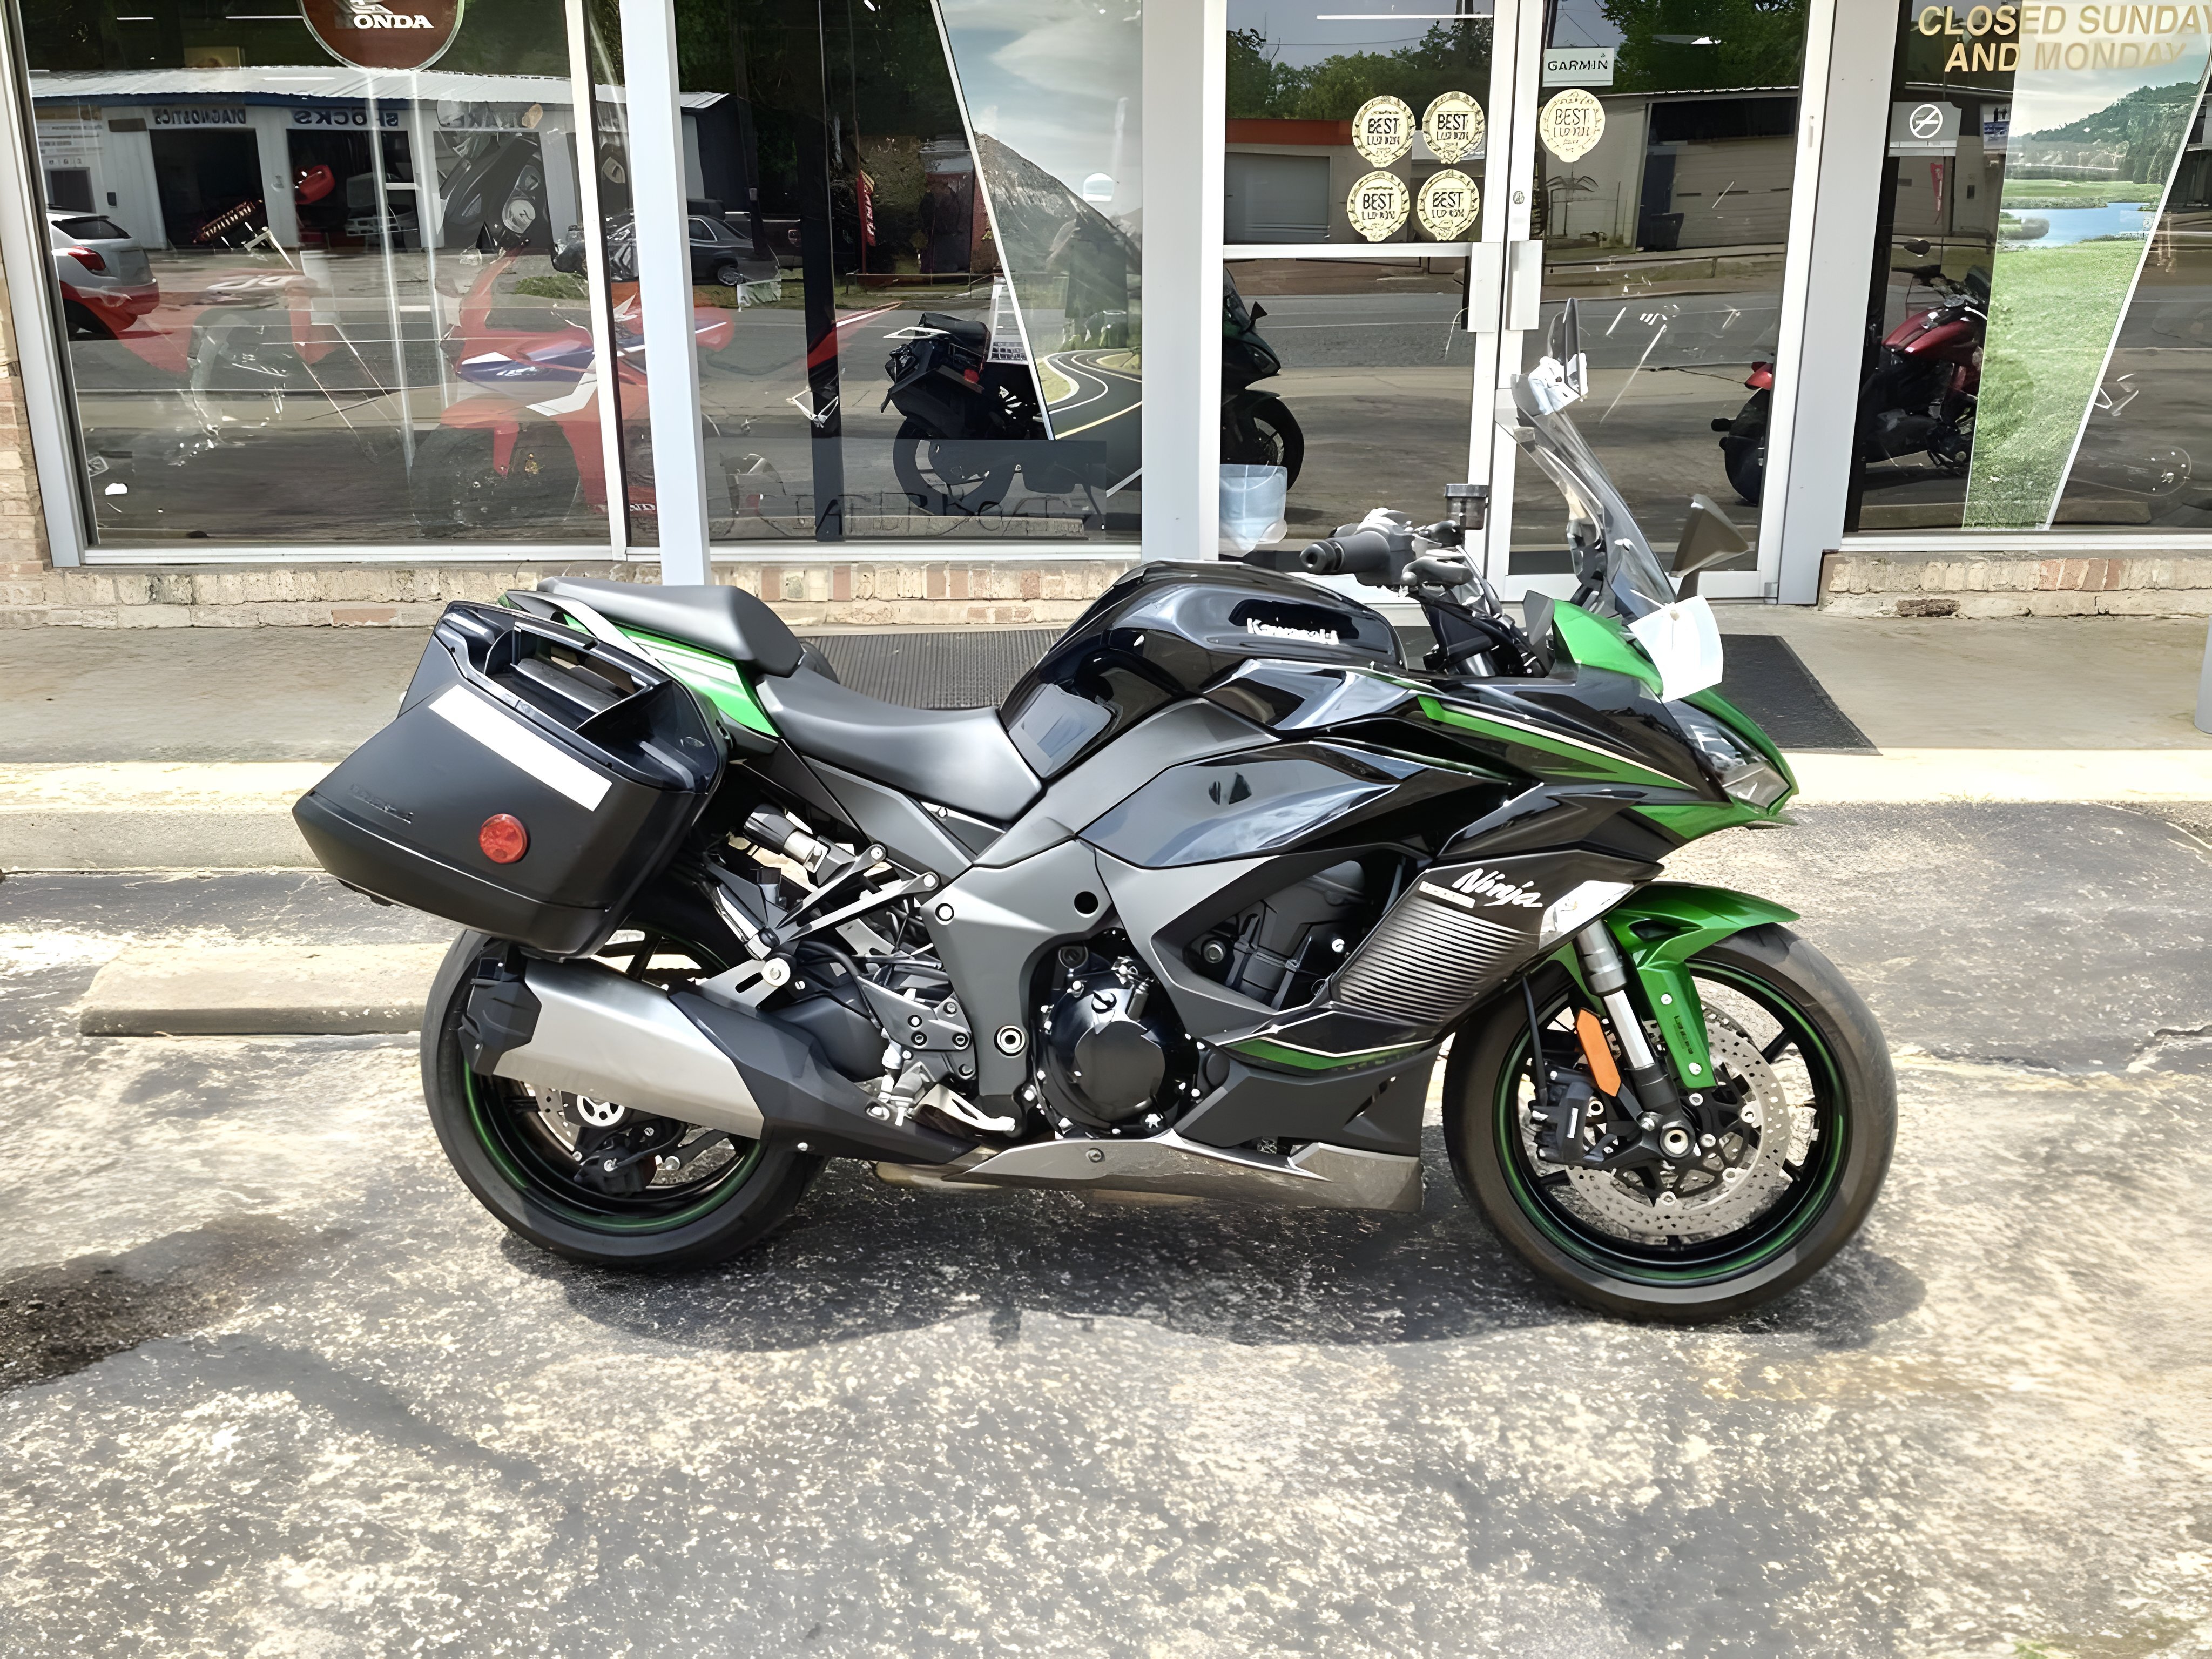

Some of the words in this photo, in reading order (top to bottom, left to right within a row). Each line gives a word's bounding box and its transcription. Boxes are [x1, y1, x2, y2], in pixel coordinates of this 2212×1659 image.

[351, 14, 434, 29] ONDA
[1918, 5, 2066, 36] CLOSED
[1547, 60, 1608, 71] GARMIN
[1944, 43, 2020, 72] AND
[2034, 42, 2187, 70] MONDAY
[1437, 113, 1469, 130] BEST
[1554, 108, 1590, 125] BEST
[1367, 118, 1400, 134] BEST
[1363, 193, 1394, 210] BEST
[1432, 191, 1464, 208] BEST
[1451, 867, 1543, 908] Ninja
